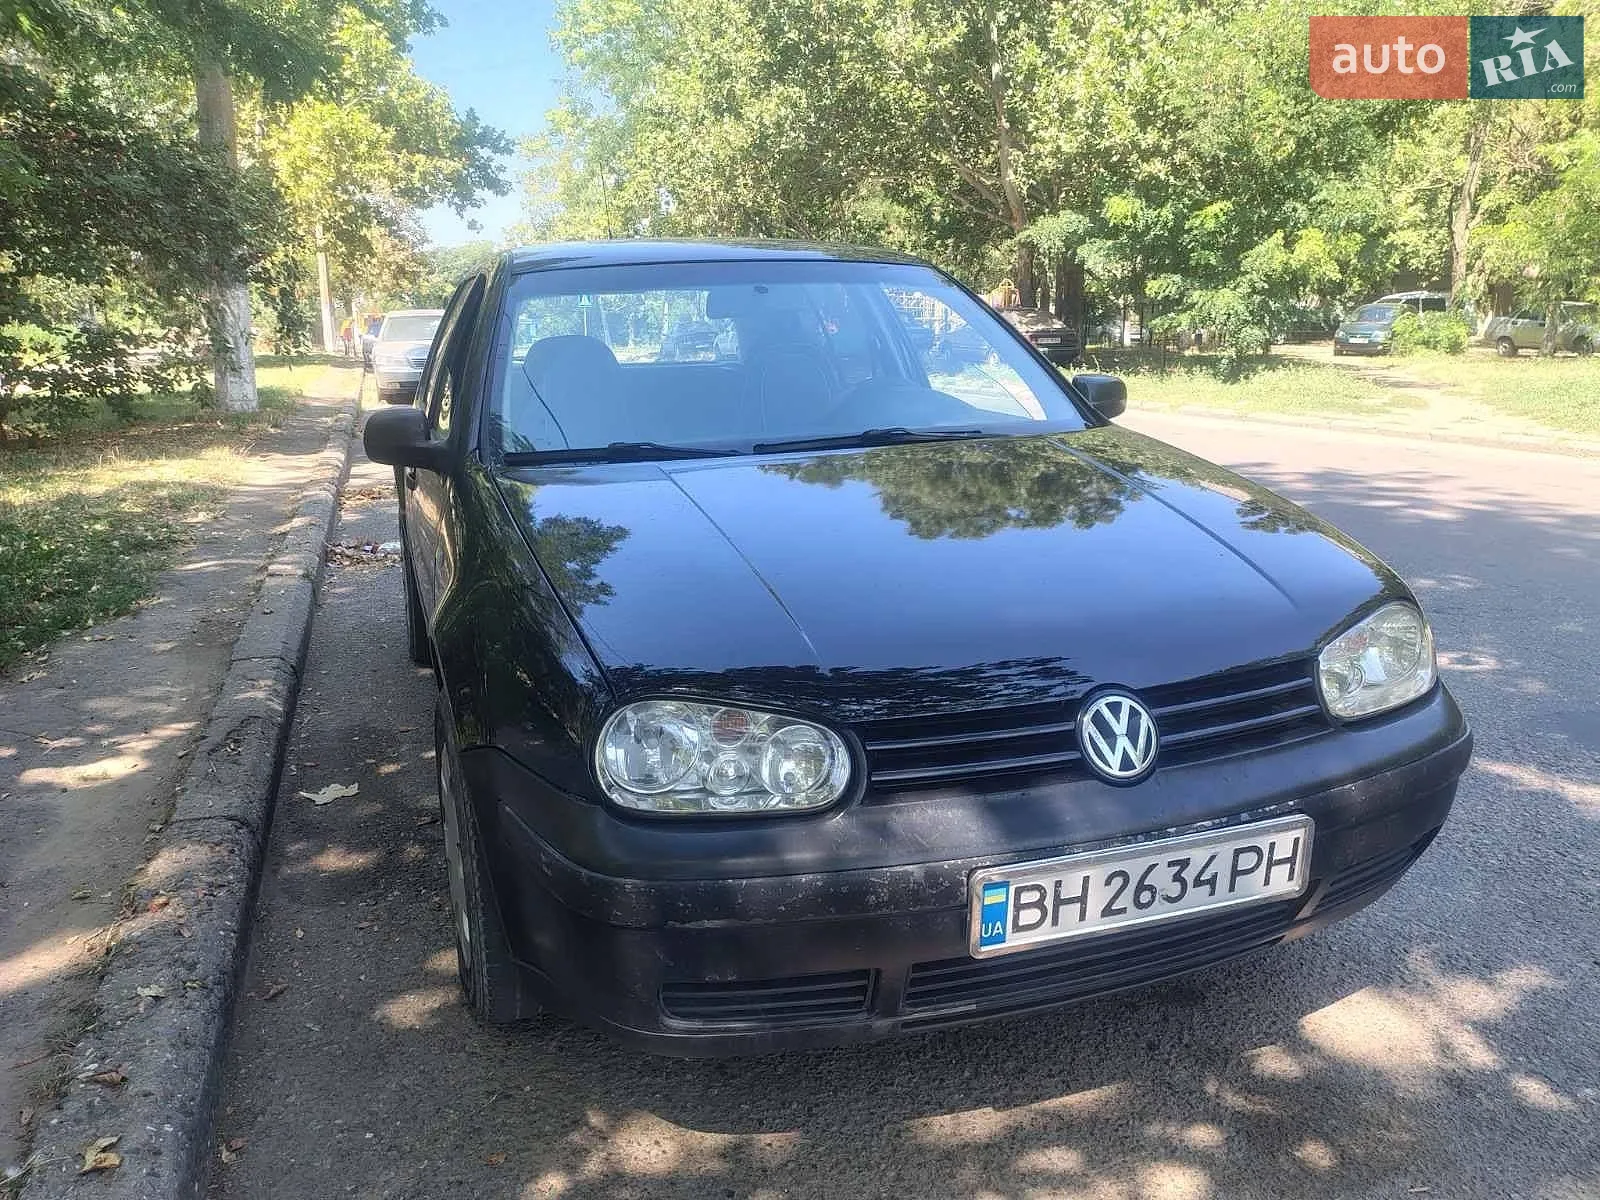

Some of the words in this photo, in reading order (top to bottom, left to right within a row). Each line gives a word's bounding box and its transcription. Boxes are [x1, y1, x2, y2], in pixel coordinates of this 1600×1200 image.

[1011, 875, 1090, 934] BH
[1100, 853, 1218, 918] 2634
[1228, 836, 1301, 893] PH
[981, 920, 1004, 938] UA
